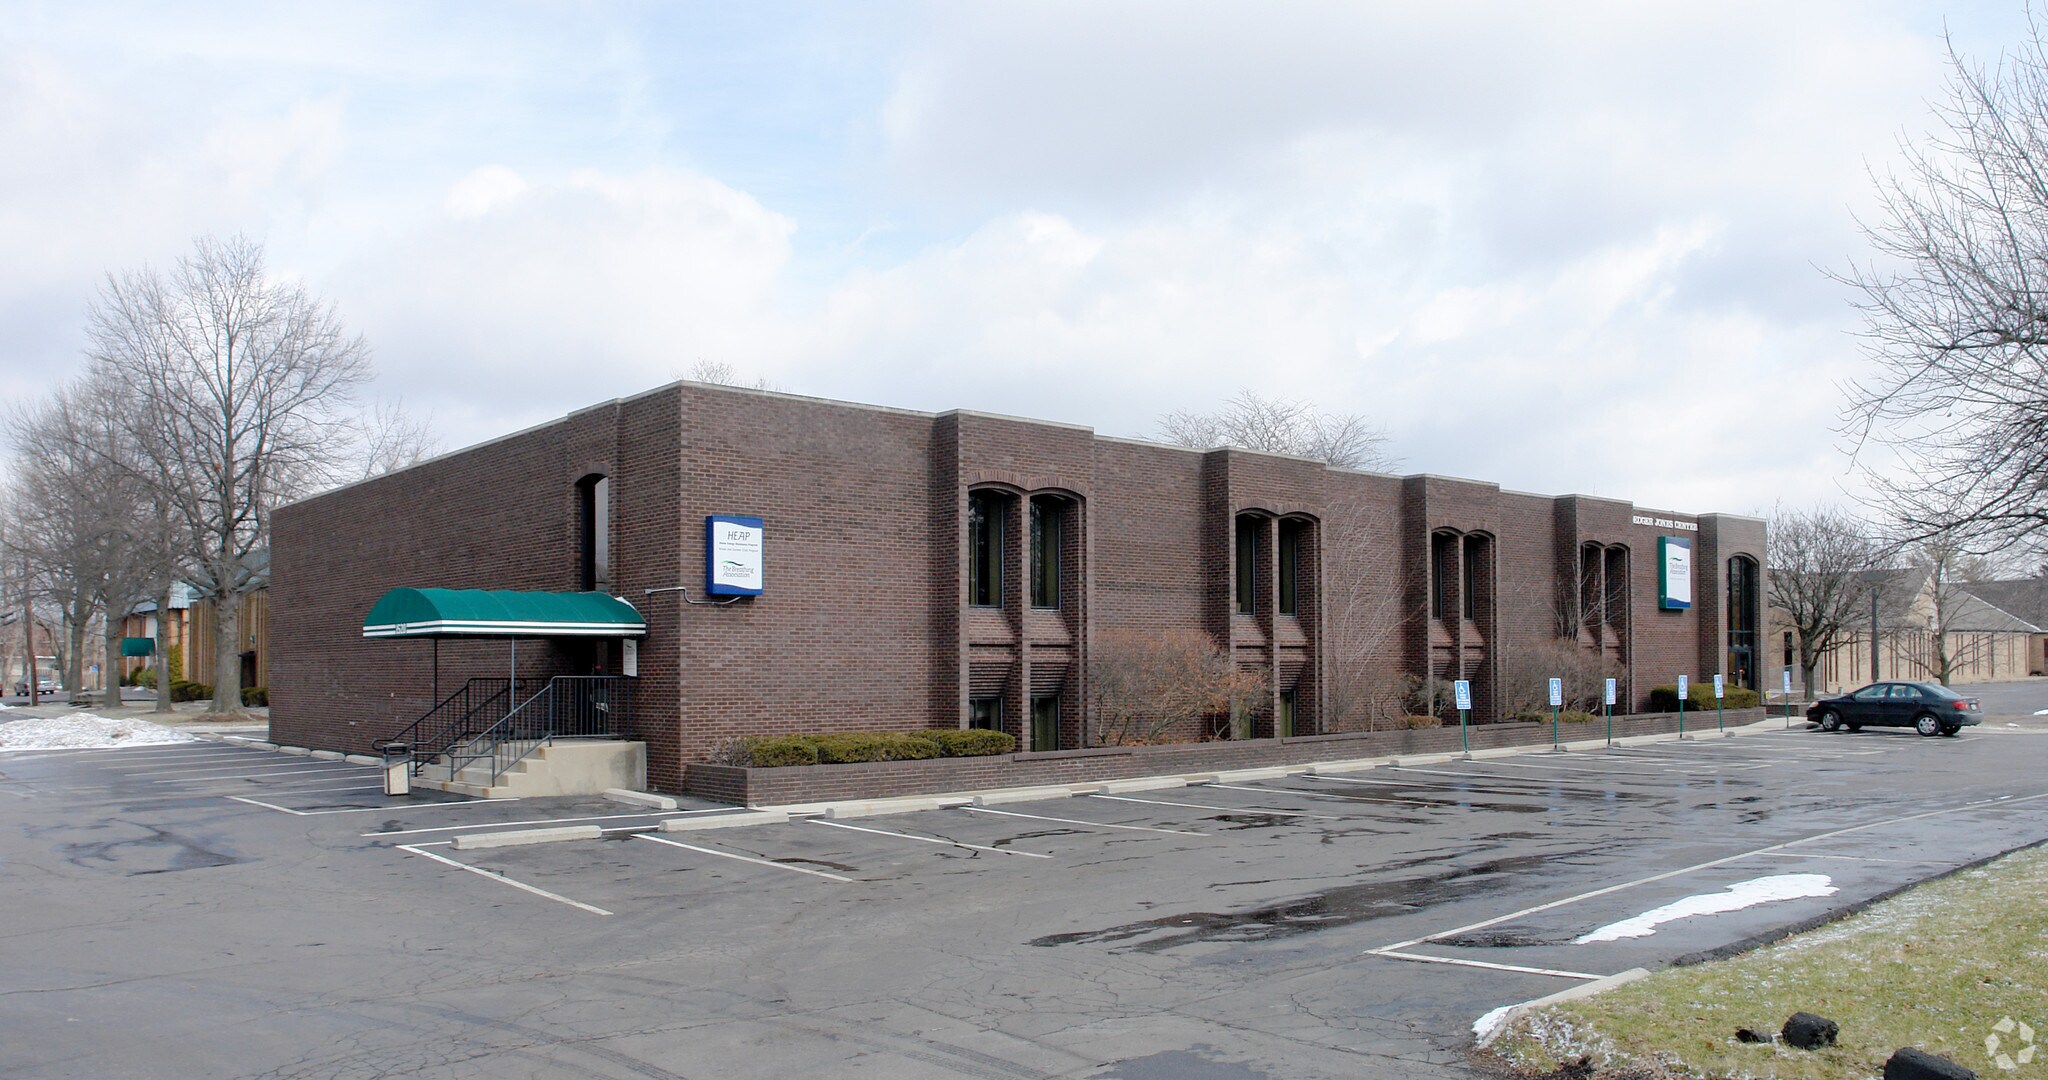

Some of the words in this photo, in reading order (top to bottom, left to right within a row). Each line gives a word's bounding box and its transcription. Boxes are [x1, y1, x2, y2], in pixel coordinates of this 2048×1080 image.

[1655, 518, 1673, 528] JONES
[1674, 520, 1698, 531] CENTER
[727, 530, 751, 541] HEAP
[722, 570, 750, 578] Association
[723, 565, 732, 573] The
[732, 565, 754, 574] Breathing
